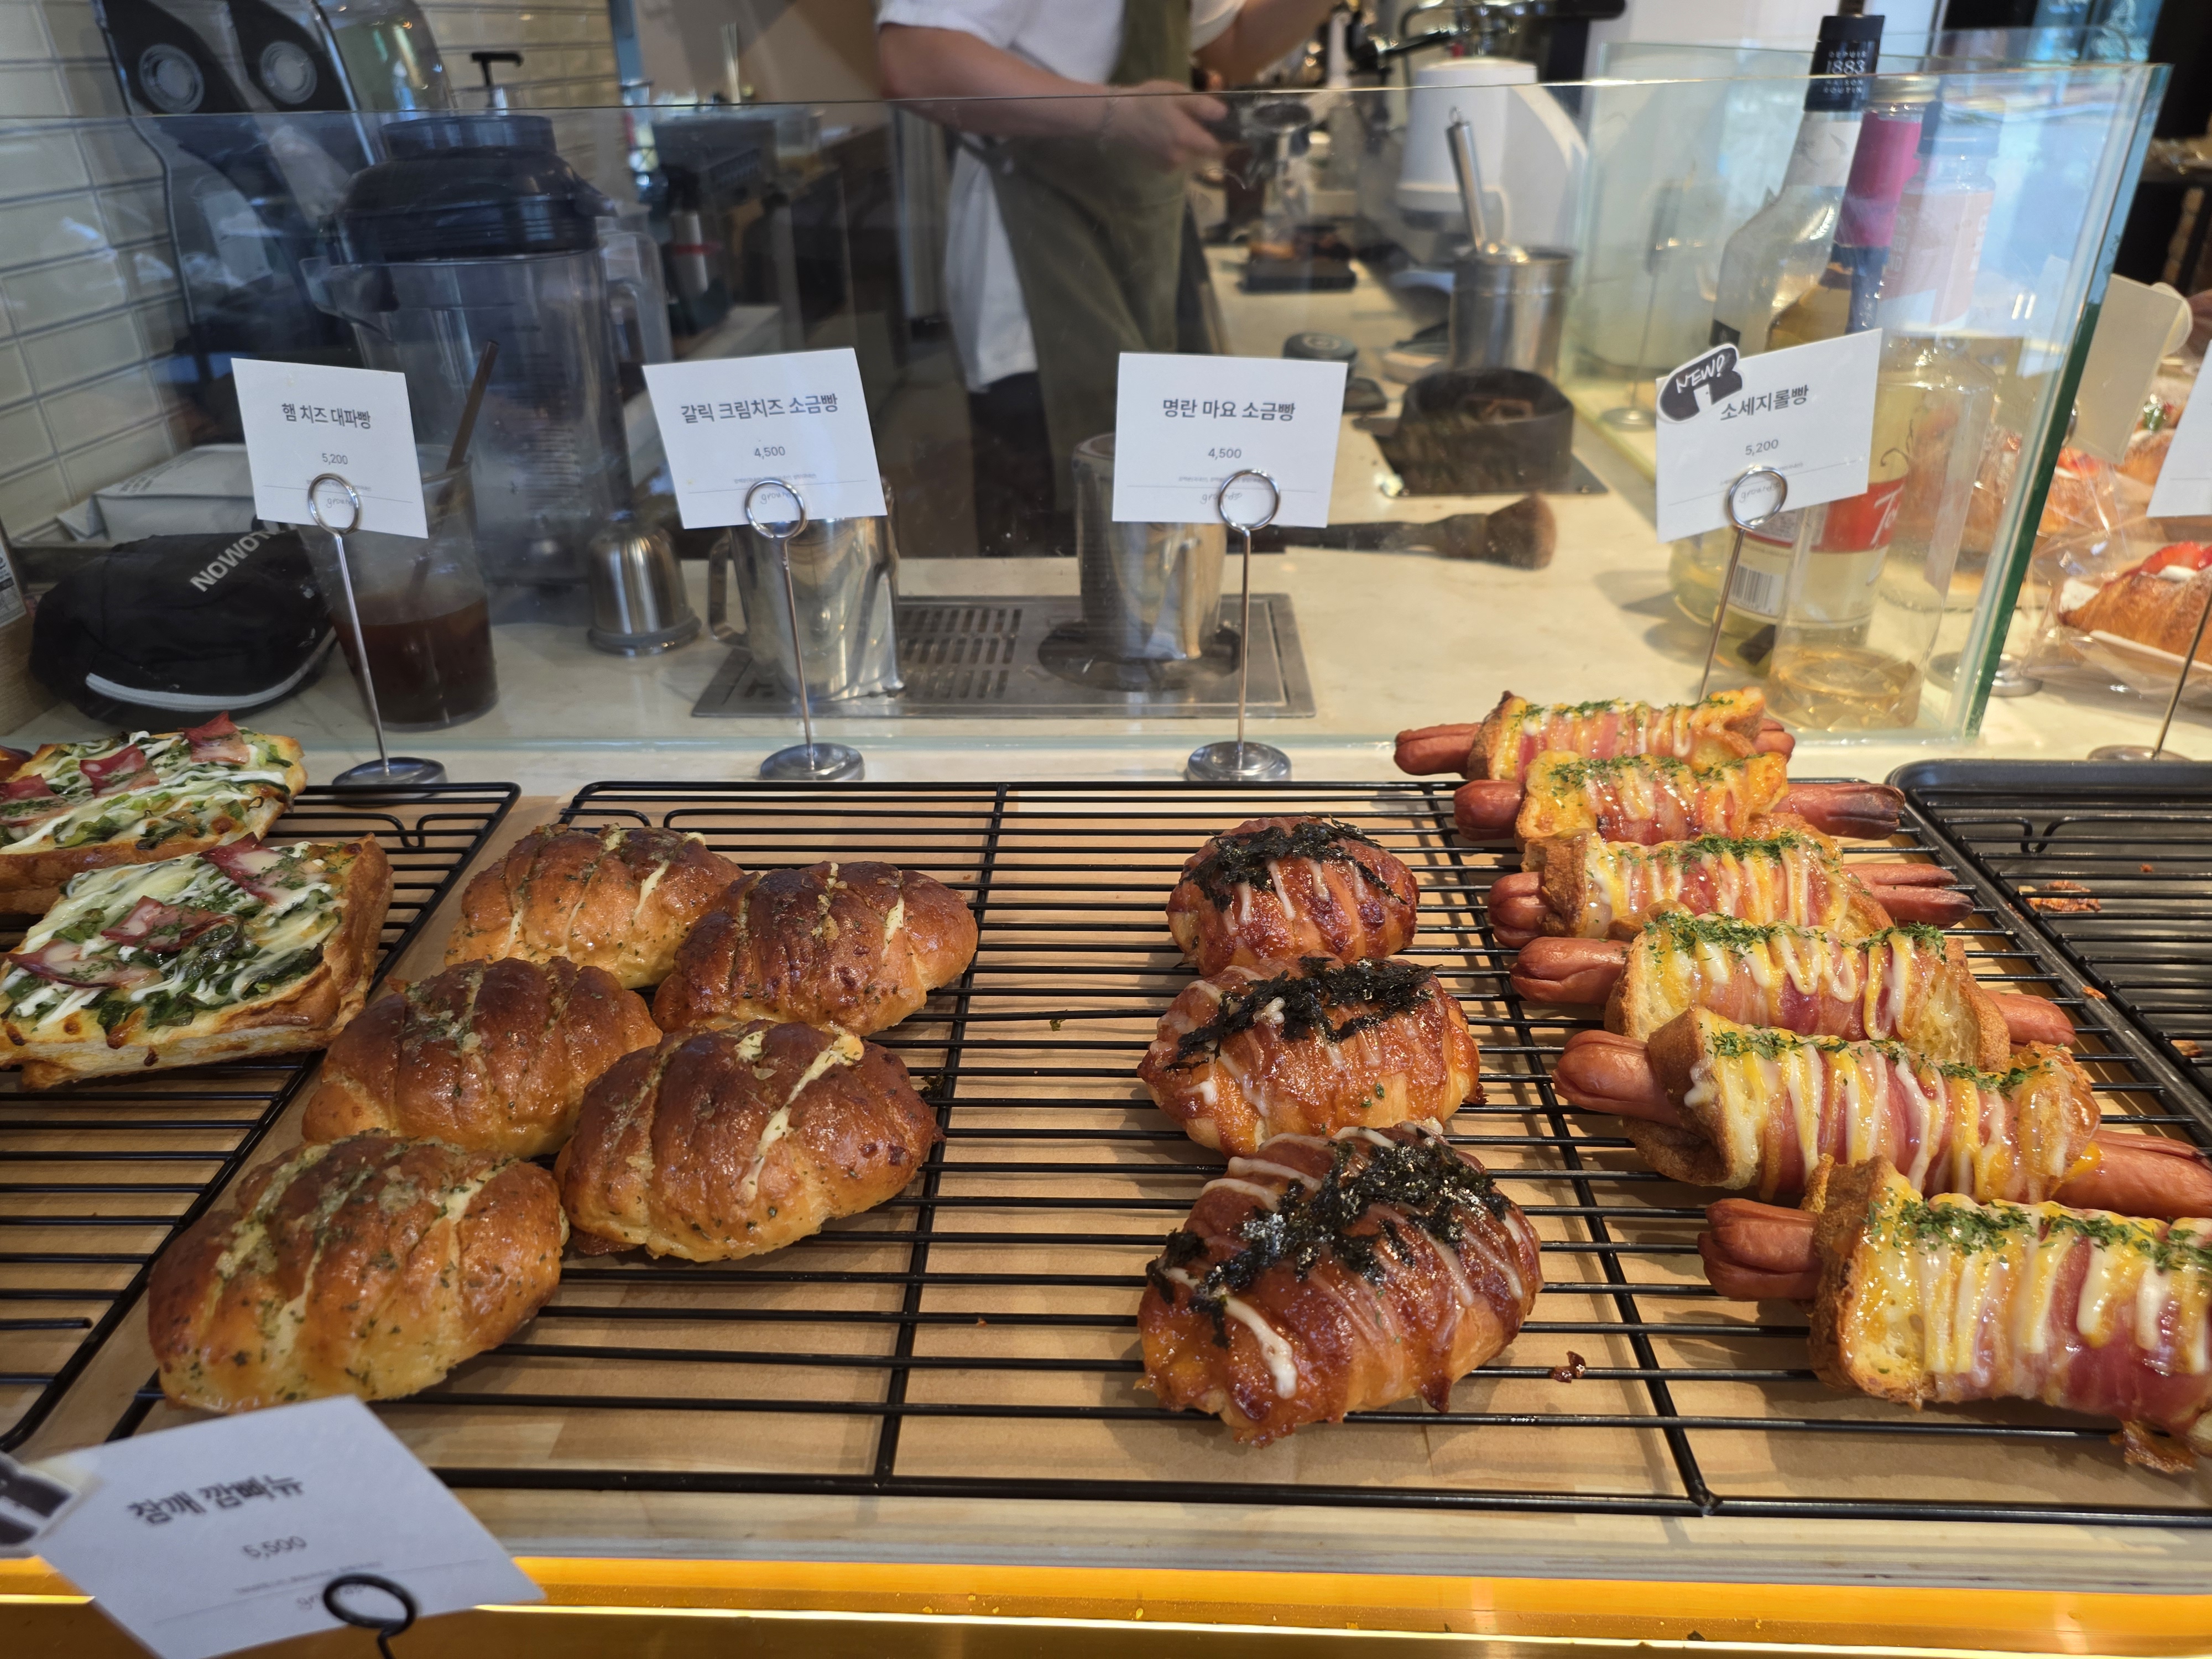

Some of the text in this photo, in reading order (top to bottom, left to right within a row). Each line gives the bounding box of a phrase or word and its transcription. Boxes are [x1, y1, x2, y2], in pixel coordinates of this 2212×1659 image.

[1825, 59, 1866, 75] 1883
[1674, 353, 1725, 394] NEW!
[680, 393, 838, 424] 갈릭 크림치즈 소금빵
[1162, 398, 1296, 422] 명란 마요 소금빵
[1719, 383, 1809, 422] 소세지롤빵
[281, 403, 371, 430] 햄 치즈 대파빵
[321, 452, 348, 466] 5,200
[754, 446, 786, 460] 4,500
[1208, 448, 1242, 460] 4,500
[1745, 439, 1779, 456] 5,200
[127, 1474, 304, 1525] 참깨 깜빠뉴
[242, 1535, 307, 1559] 5,500
